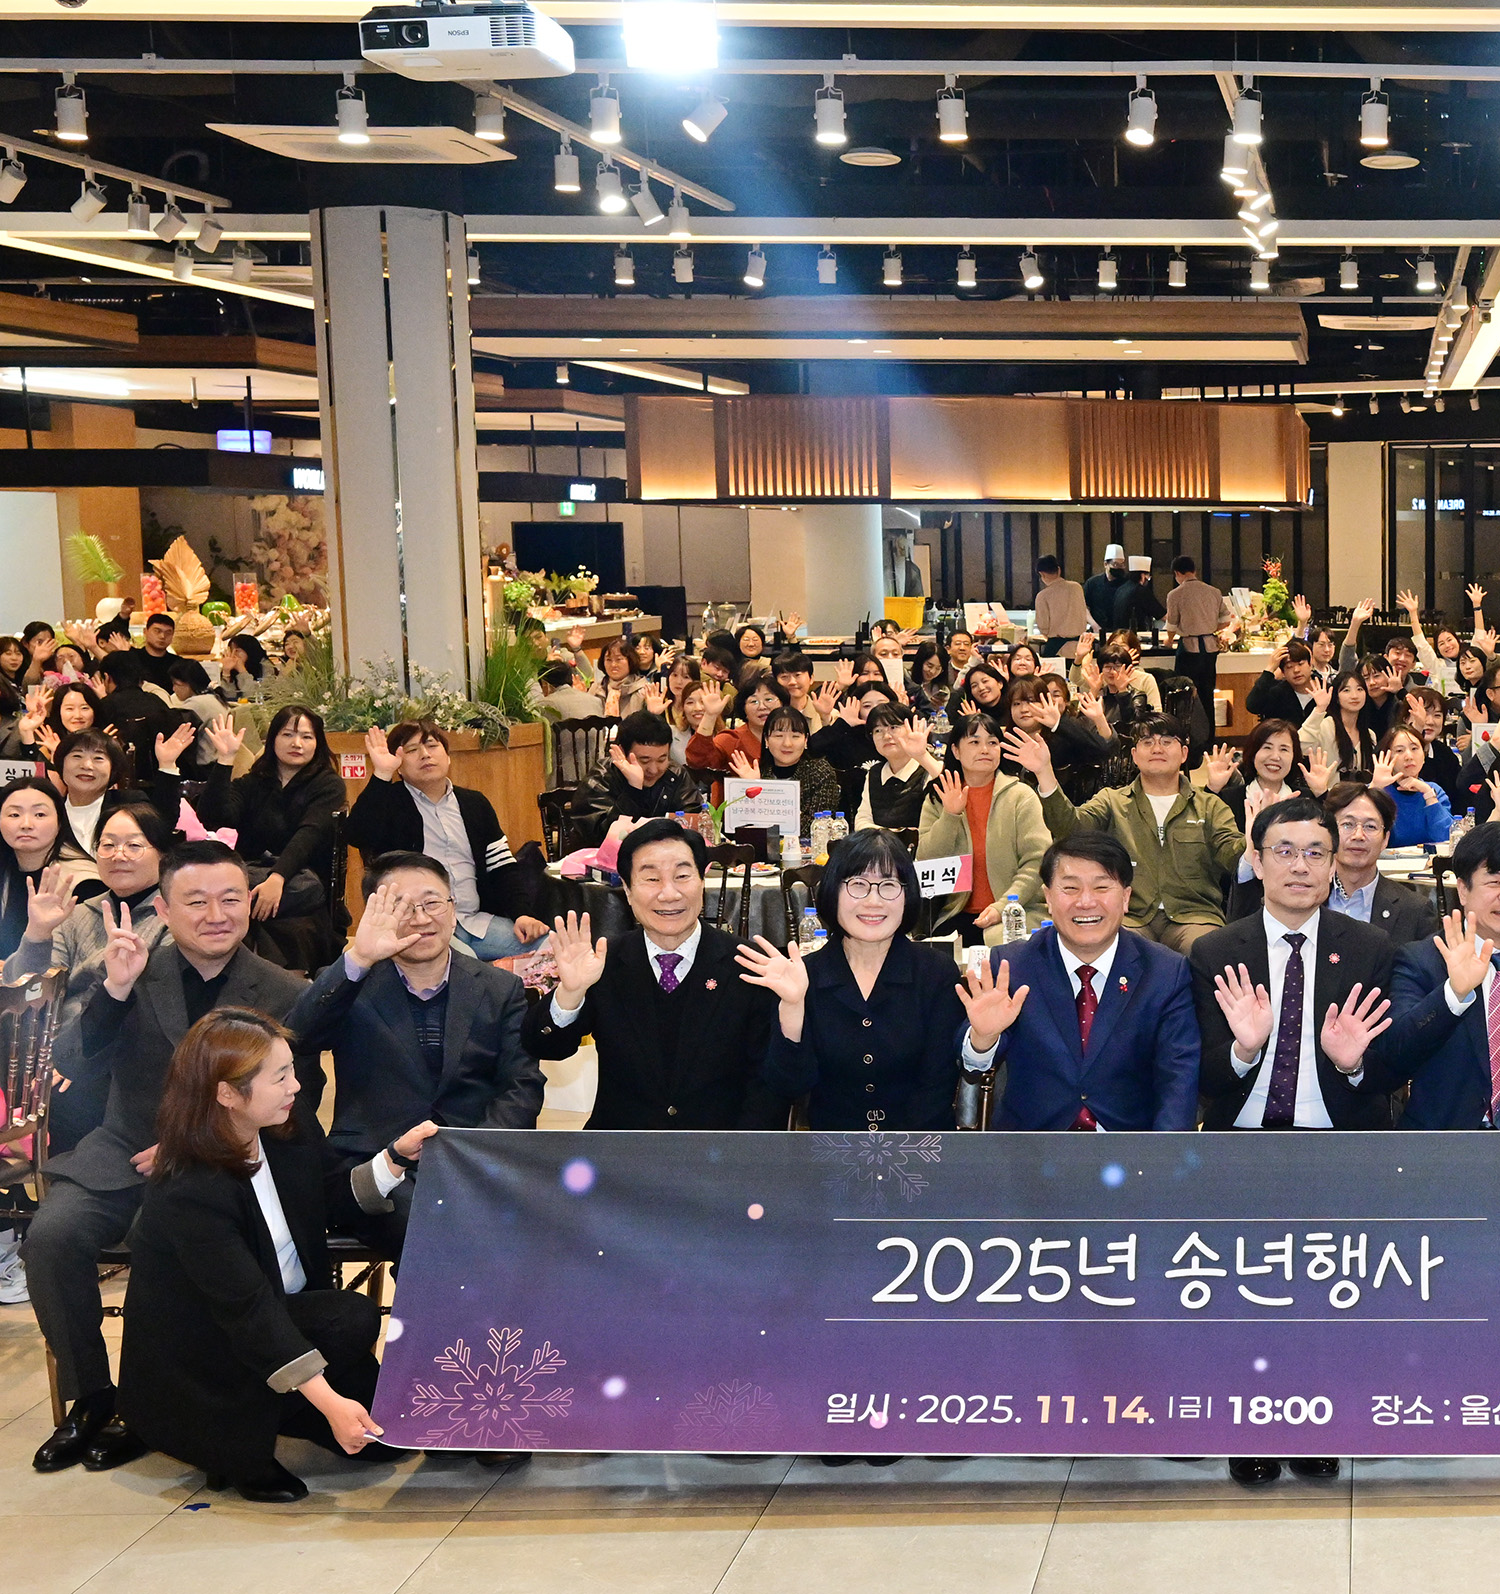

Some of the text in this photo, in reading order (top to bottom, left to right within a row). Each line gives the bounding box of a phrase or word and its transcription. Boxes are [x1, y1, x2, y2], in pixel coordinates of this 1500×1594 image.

[757, 808, 794, 817] 주간보호센터
[872, 1231, 1445, 1309] 2025년 송년행사
[827, 1393, 890, 1425] 일시
[916, 1395, 1022, 1425] 2025.
[1037, 1396, 1088, 1424] 11.
[1103, 1396, 1155, 1424] 14.
[1228, 1396, 1334, 1425] 18:00
[1371, 1395, 1434, 1425] 장소
